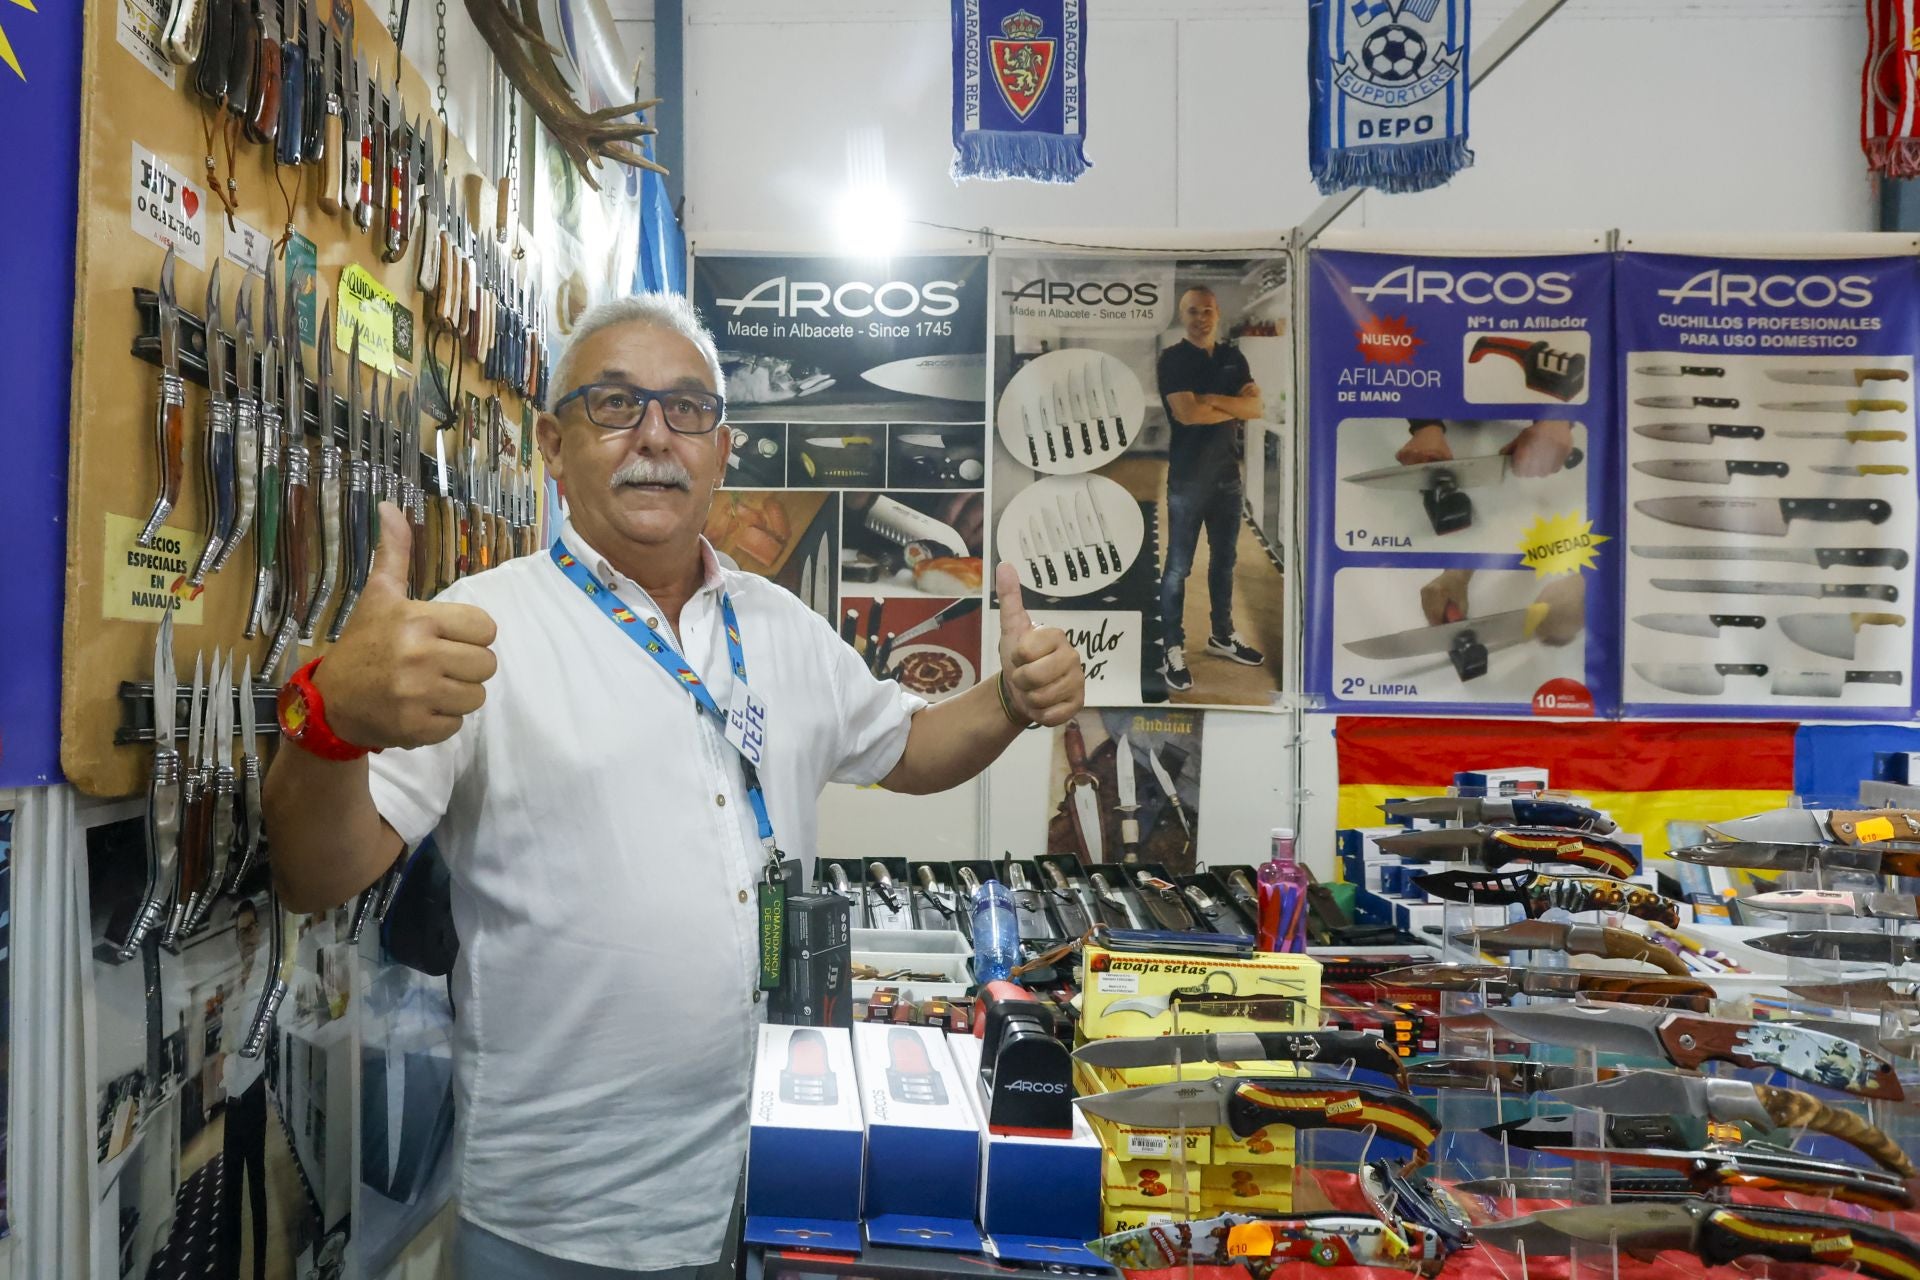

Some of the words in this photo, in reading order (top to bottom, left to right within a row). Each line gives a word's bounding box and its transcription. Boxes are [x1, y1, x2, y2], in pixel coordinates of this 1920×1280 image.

[966, 0, 979, 80] ZARAGOZA
[1065, 0, 1077, 81] ZARAGOZA
[1340, 66, 1452, 104] SUPPORTERS
[966, 83, 979, 121] REAL
[1065, 85, 1078, 124] REAL
[1358, 115, 1434, 139] DEPO
[138, 196, 147, 212] O
[150, 203, 200, 246] GALEGO
[1002, 278, 1159, 306] ARCOS
[1351, 265, 1573, 305] ARCOS
[1658, 269, 1873, 307] ARCOS
[715, 276, 960, 318] ARCOS
[1009, 305, 1035, 317] Made
[1038, 308, 1047, 317] in
[1049, 309, 1090, 319] Albacete
[1100, 309, 1127, 319] Since
[1131, 310, 1154, 319] 1745
[1499, 318, 1519, 328] en
[1524, 316, 1587, 329] Afilador
[1658, 313, 1743, 329] CUCHILLOS
[1747, 317, 1881, 331] PROFESIONALES
[298, 315, 309, 332] 62
[339, 306, 390, 352] NAVAJAS
[727, 321, 768, 337] Made
[773, 322, 785, 337] in
[790, 322, 853, 338] Albacete
[869, 322, 909, 338] Since
[915, 321, 952, 336] 1745
[1361, 332, 1412, 347] NUEVO
[1680, 333, 1719, 346] PARA
[1723, 334, 1756, 347] USO
[1760, 335, 1858, 348] DOMESTICO
[1338, 368, 1442, 388] AFILADOR
[1338, 391, 1356, 402] DE
[1360, 391, 1401, 402] MANO
[1371, 535, 1412, 547] AFILA
[1526, 533, 1591, 563] NOVEDAD
[127, 551, 187, 574] ESPECIALES
[150, 574, 165, 589] EN
[132, 591, 181, 610] NAVAJAS
[1065, 617, 1124, 660] ando
[1369, 684, 1418, 696] LIMPIA
[1536, 694, 1556, 708] 10
[731, 709, 744, 730] EL
[742, 694, 764, 763] JEFE
[764, 907, 772, 922] DE
[764, 923, 772, 972] BADAJOZ
[771, 900, 781, 979] COMANDANCIA
[1164, 963, 1207, 975] setas
[1004, 1079, 1063, 1094] ARCOS
